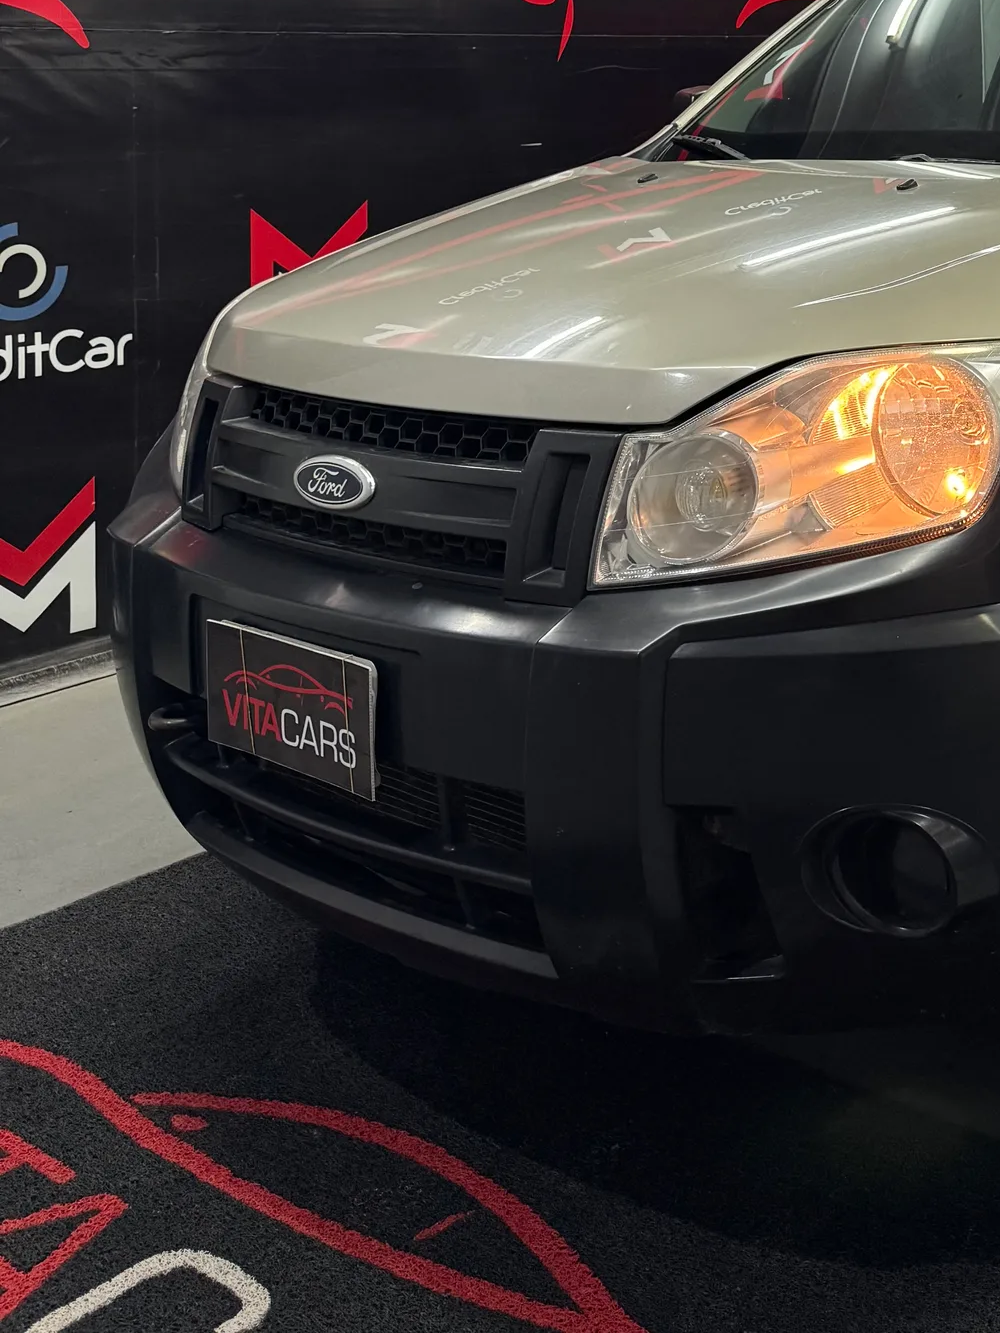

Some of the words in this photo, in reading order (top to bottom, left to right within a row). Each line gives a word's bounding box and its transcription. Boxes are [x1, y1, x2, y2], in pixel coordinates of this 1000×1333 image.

[0, 328, 134, 382] ditCar
[307, 467, 348, 498] Ford
[221, 688, 357, 770] VITACARS
